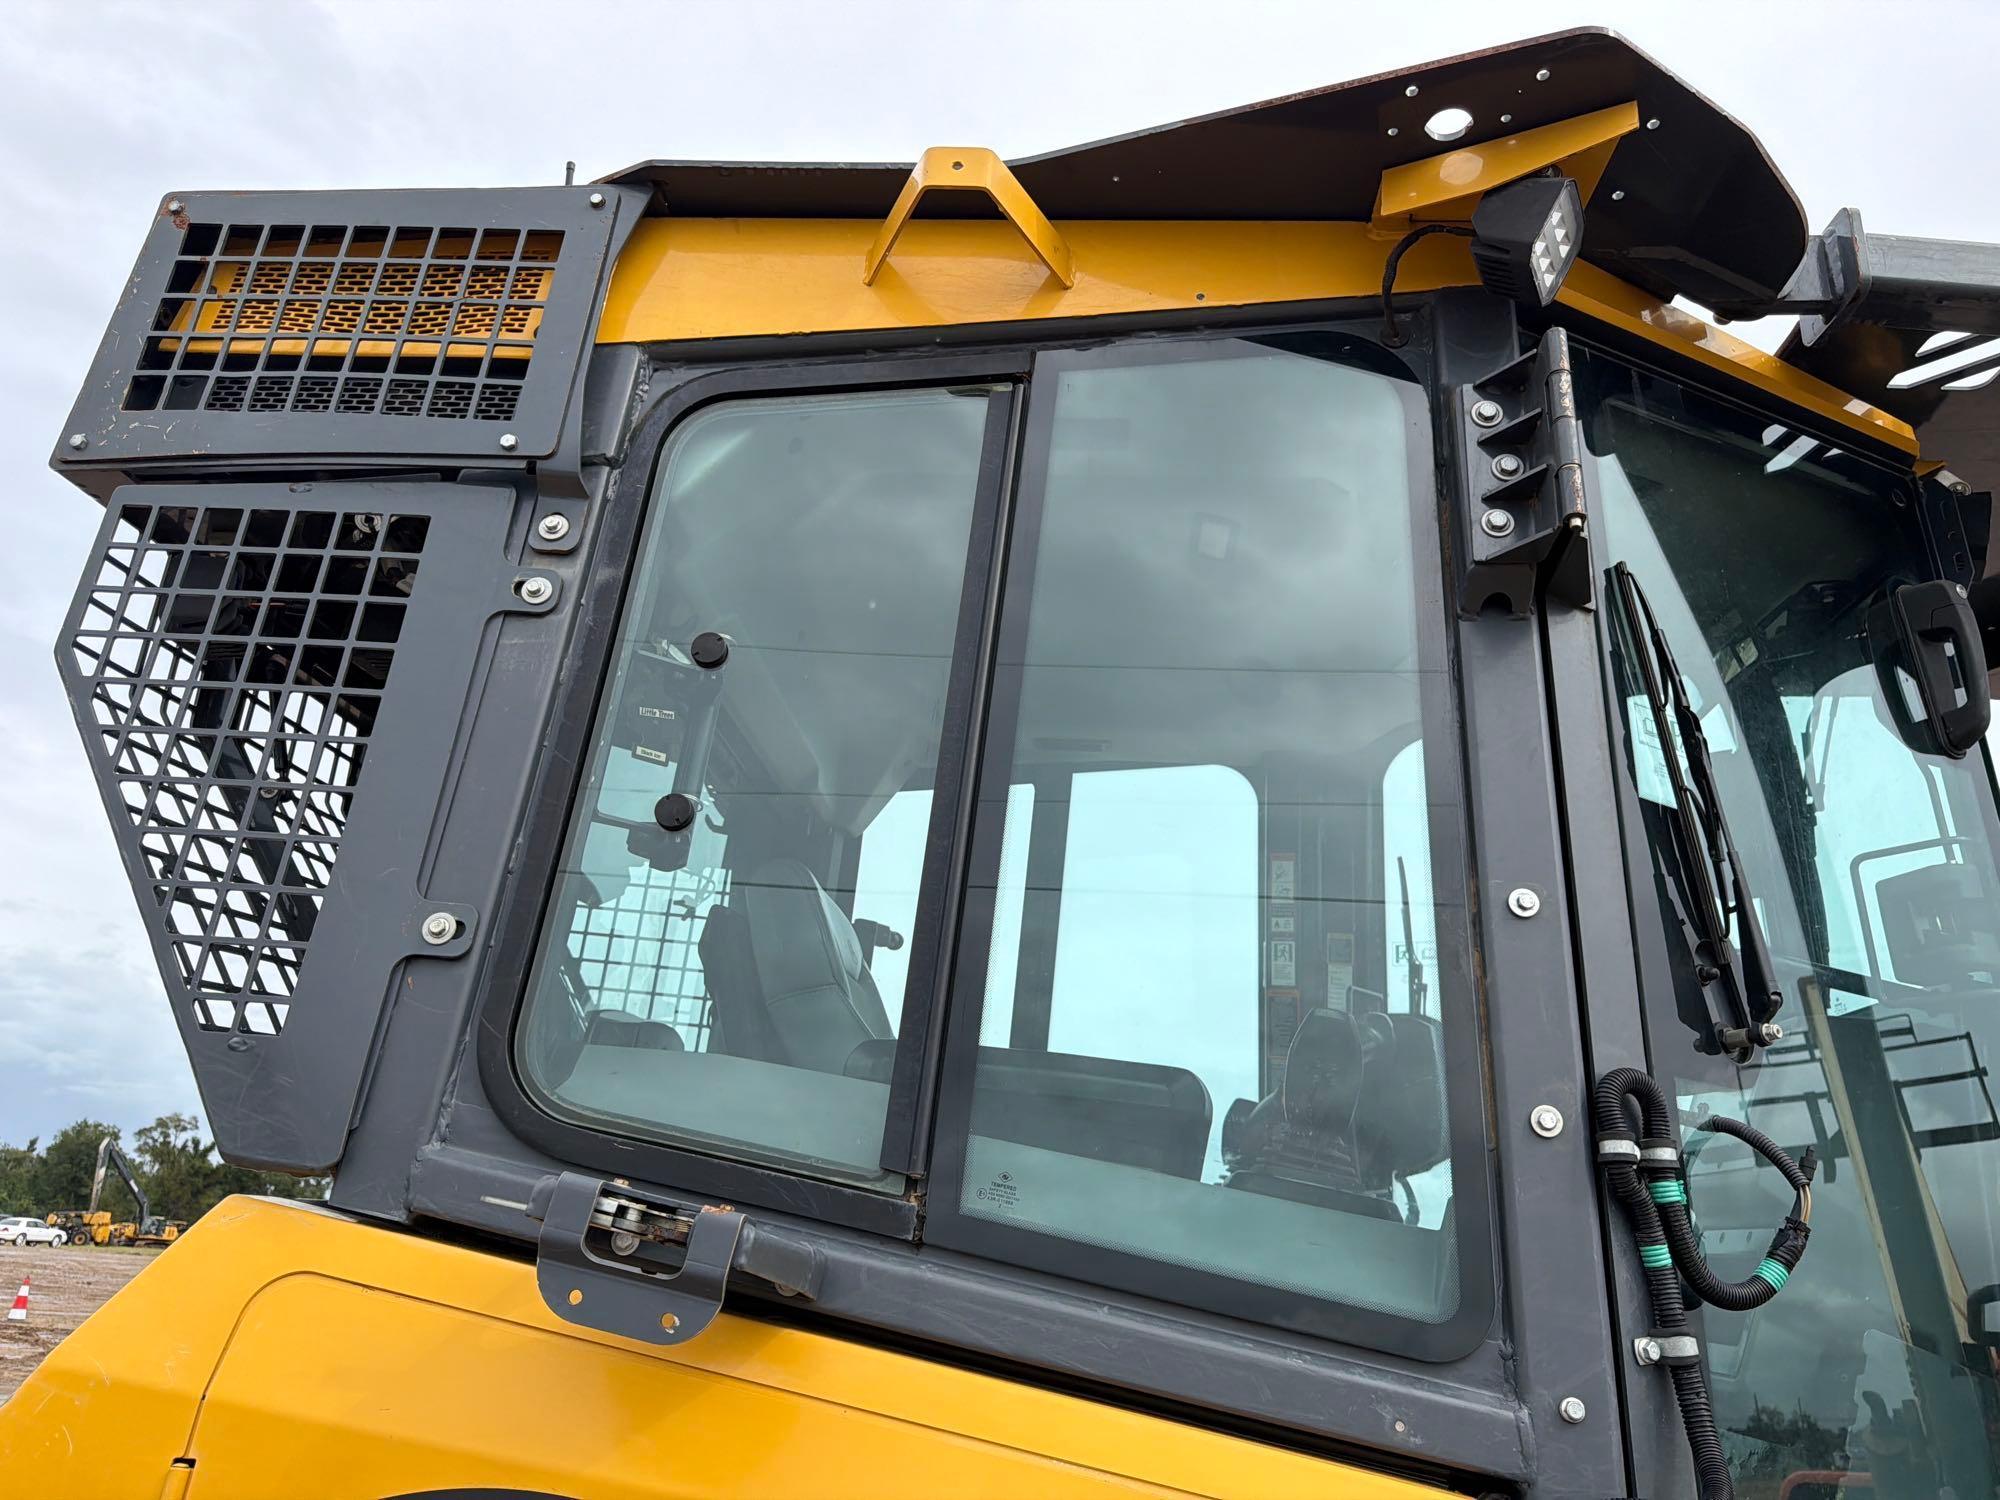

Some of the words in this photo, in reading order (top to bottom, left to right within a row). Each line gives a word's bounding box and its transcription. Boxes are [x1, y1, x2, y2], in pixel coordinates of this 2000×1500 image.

[641, 708, 657, 717] Little
[659, 711, 673, 719] Trees
[991, 1182, 1017, 1191] TEMPERED
